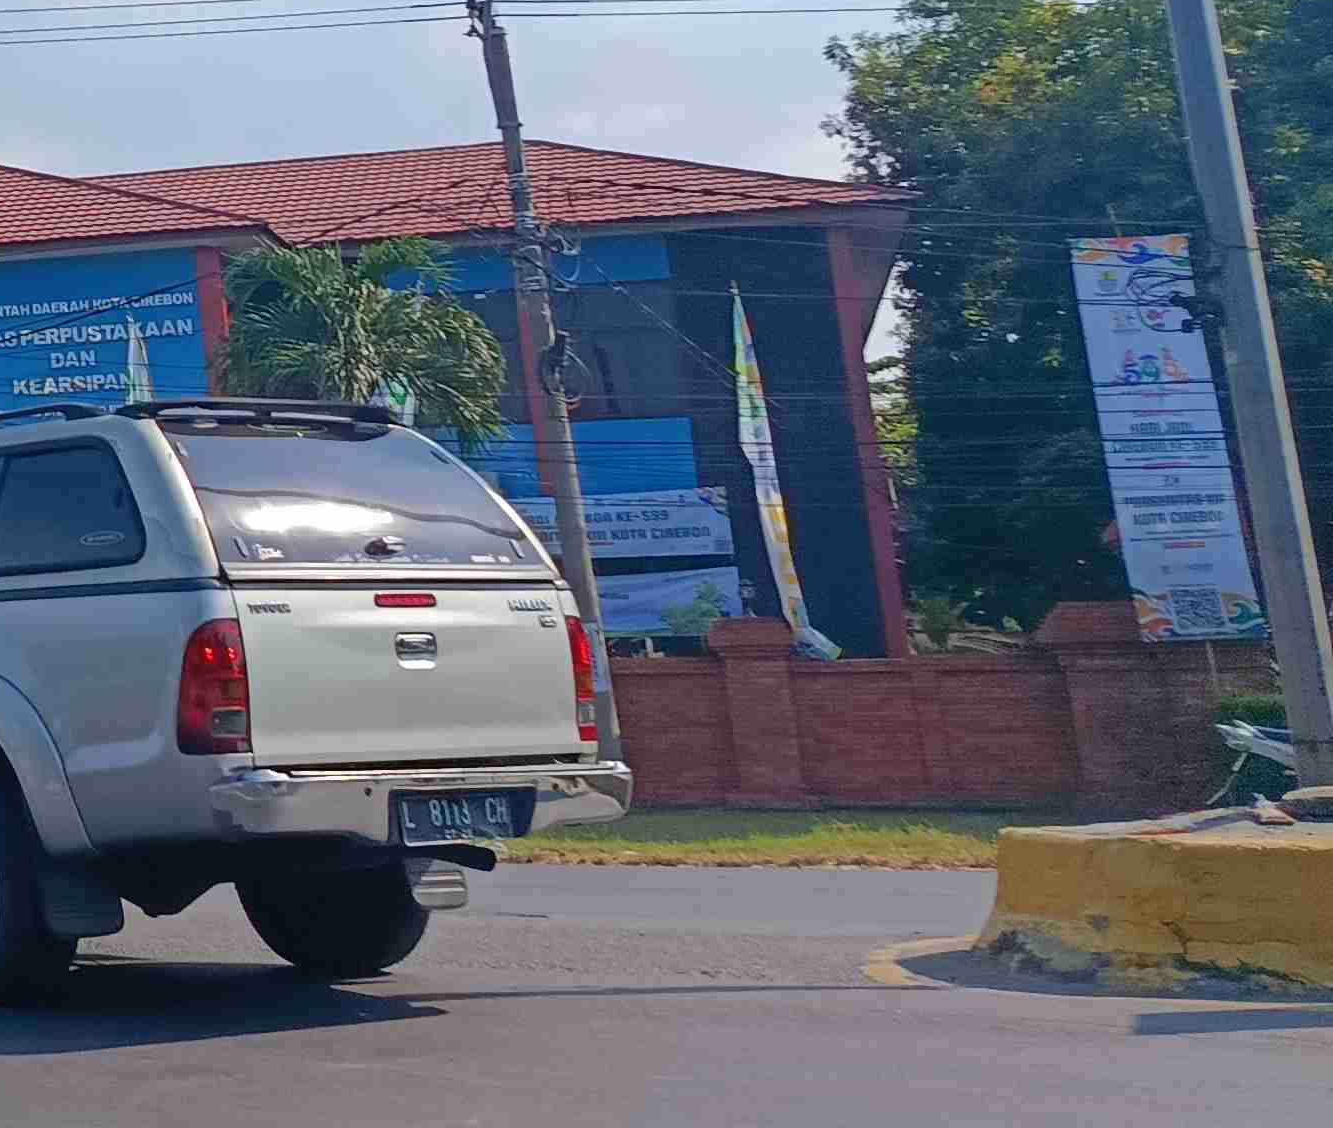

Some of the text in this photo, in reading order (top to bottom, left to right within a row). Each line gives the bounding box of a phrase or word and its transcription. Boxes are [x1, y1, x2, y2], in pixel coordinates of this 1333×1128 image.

[33, 300, 89, 314] DAERAH
[92, 296, 130, 310] KOTA
[132, 292, 194, 308] CIREBON
[20, 318, 194, 345] PERPUSTAKAAN
[50, 350, 96, 368] DAN
[402, 801, 416, 828] L
